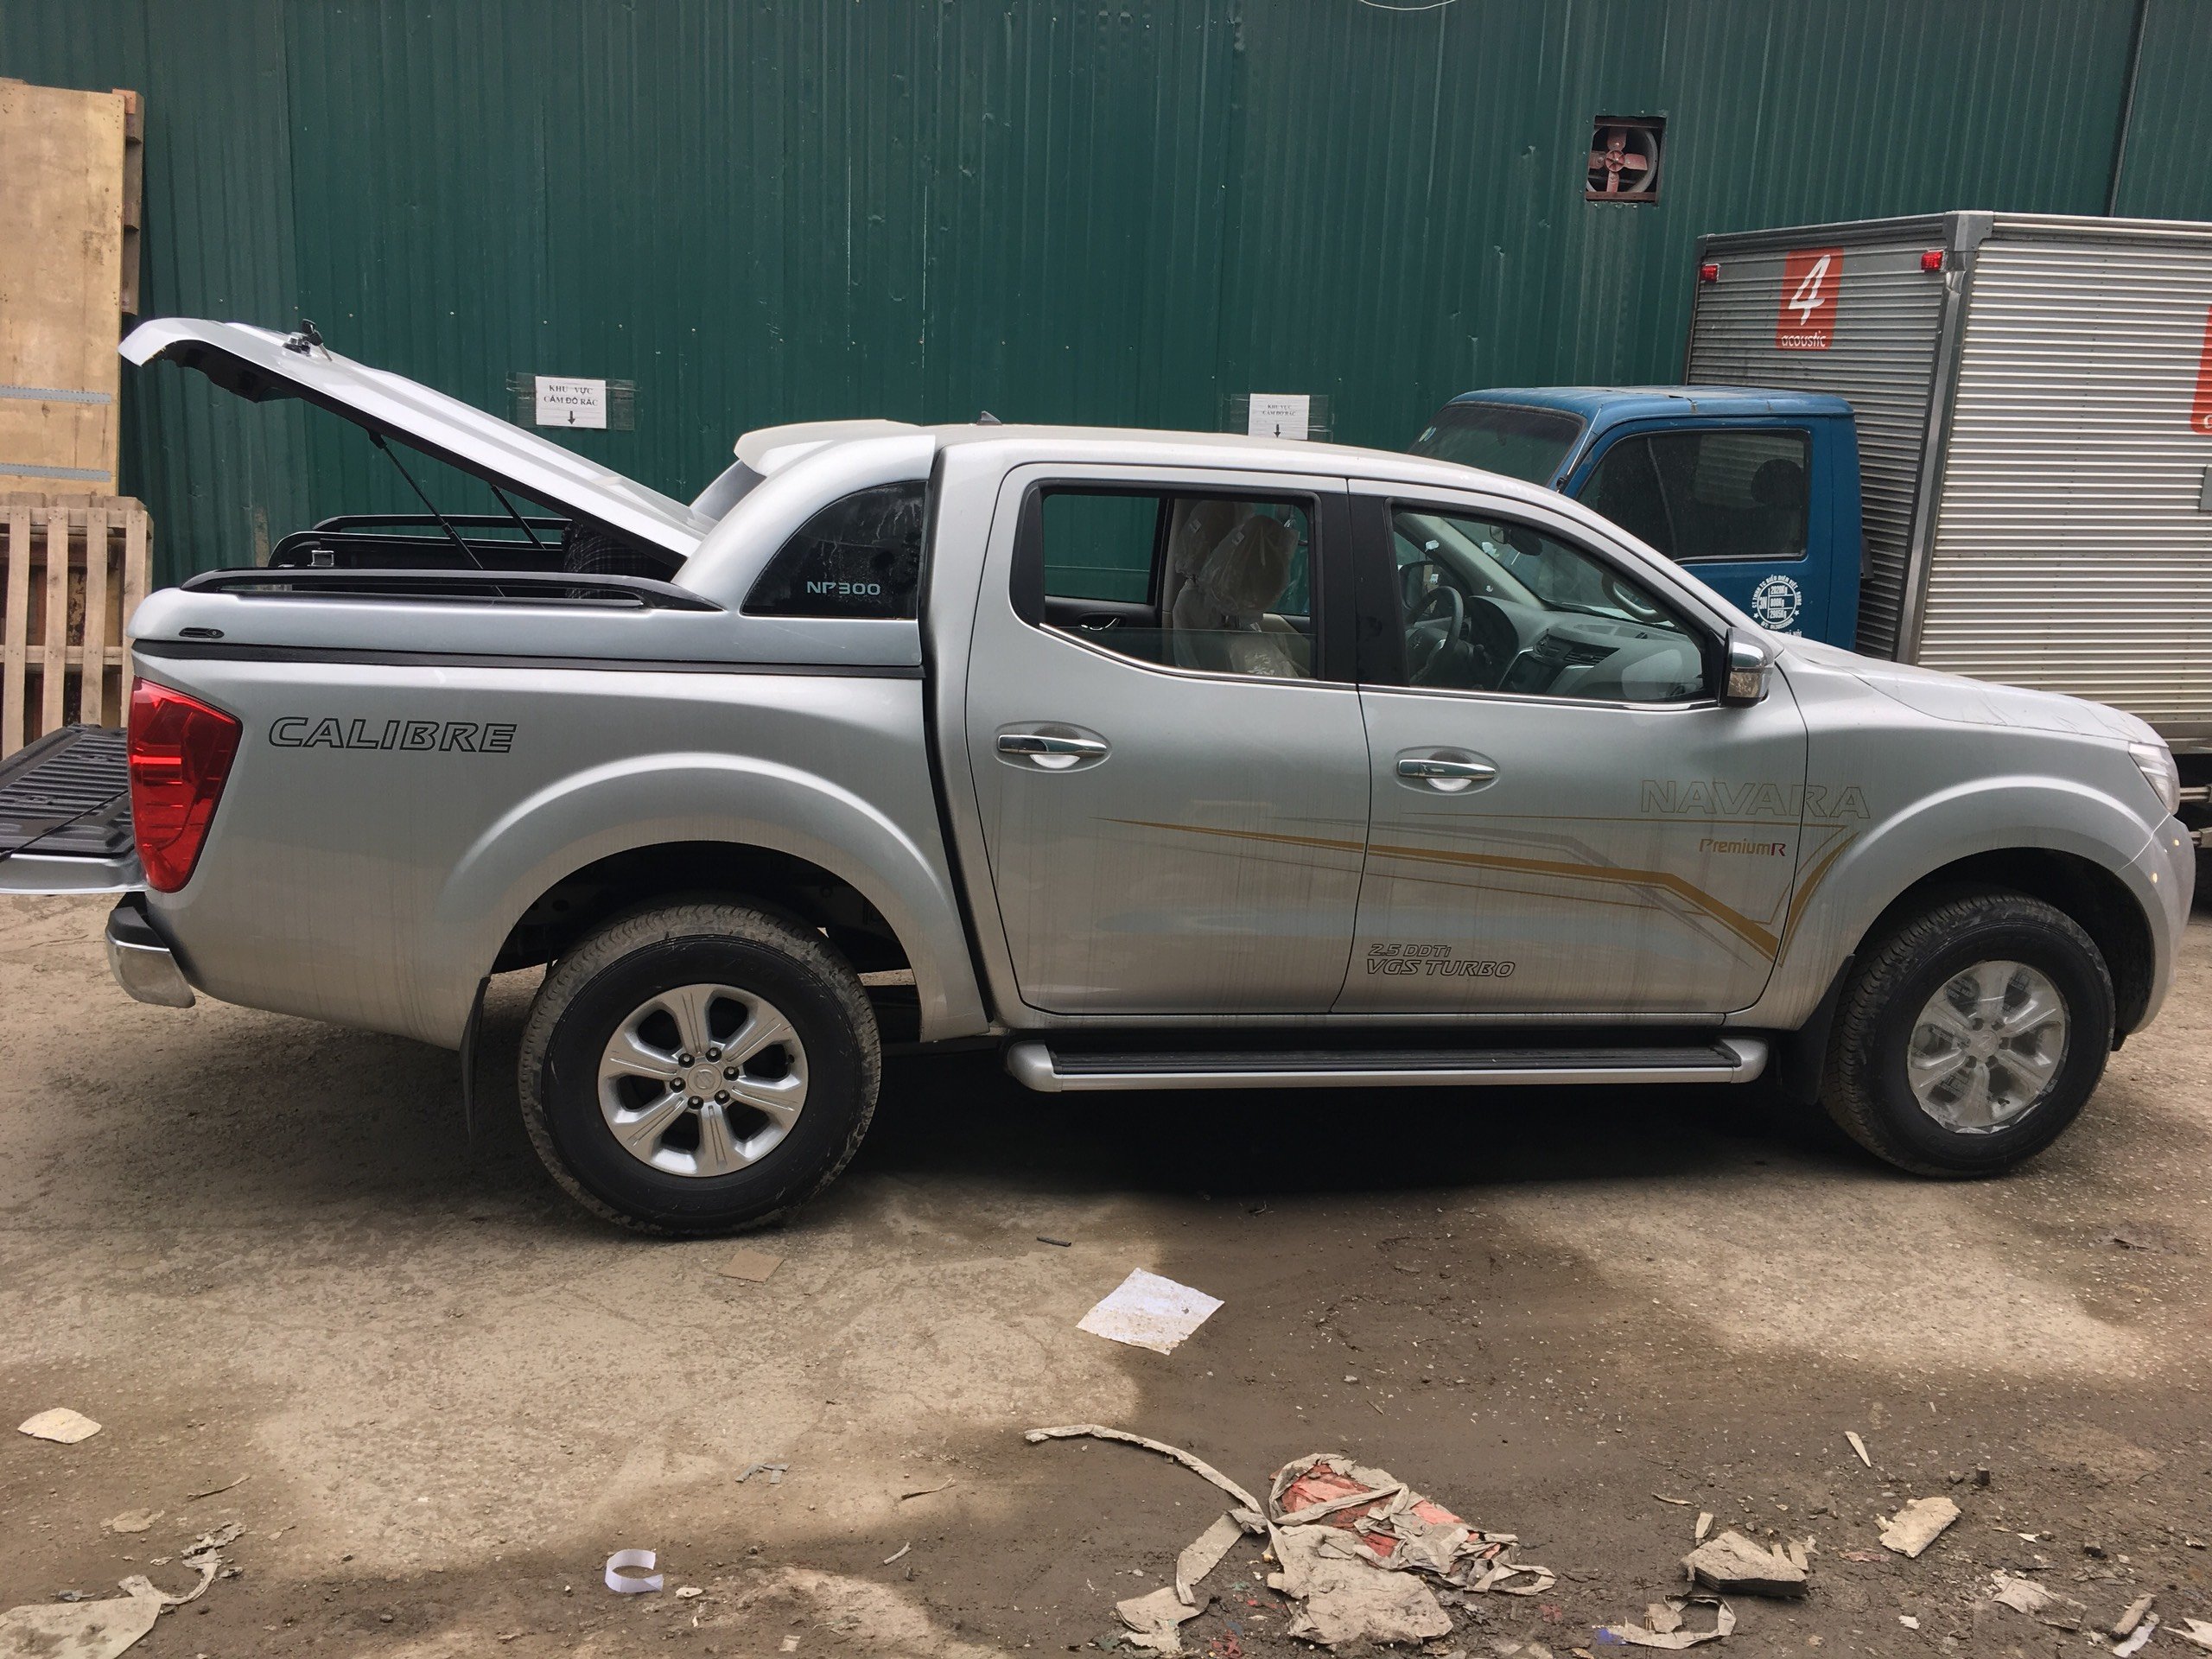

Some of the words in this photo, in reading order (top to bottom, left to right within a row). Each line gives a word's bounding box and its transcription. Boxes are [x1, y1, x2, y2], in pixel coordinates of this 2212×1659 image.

[1788, 254, 1831, 326] 4
[1781, 330, 1827, 347] acoustic
[549, 385, 568, 393] KHU
[806, 581, 880, 596] NP300
[268, 716, 518, 753] CALIBRE
[1641, 779, 1871, 819] NAVARA
[1368, 944, 1402, 957] 2.5
[1402, 944, 1452, 958] DDTi
[1366, 958, 1421, 976] VGS
[1425, 959, 1516, 977] TURBO
